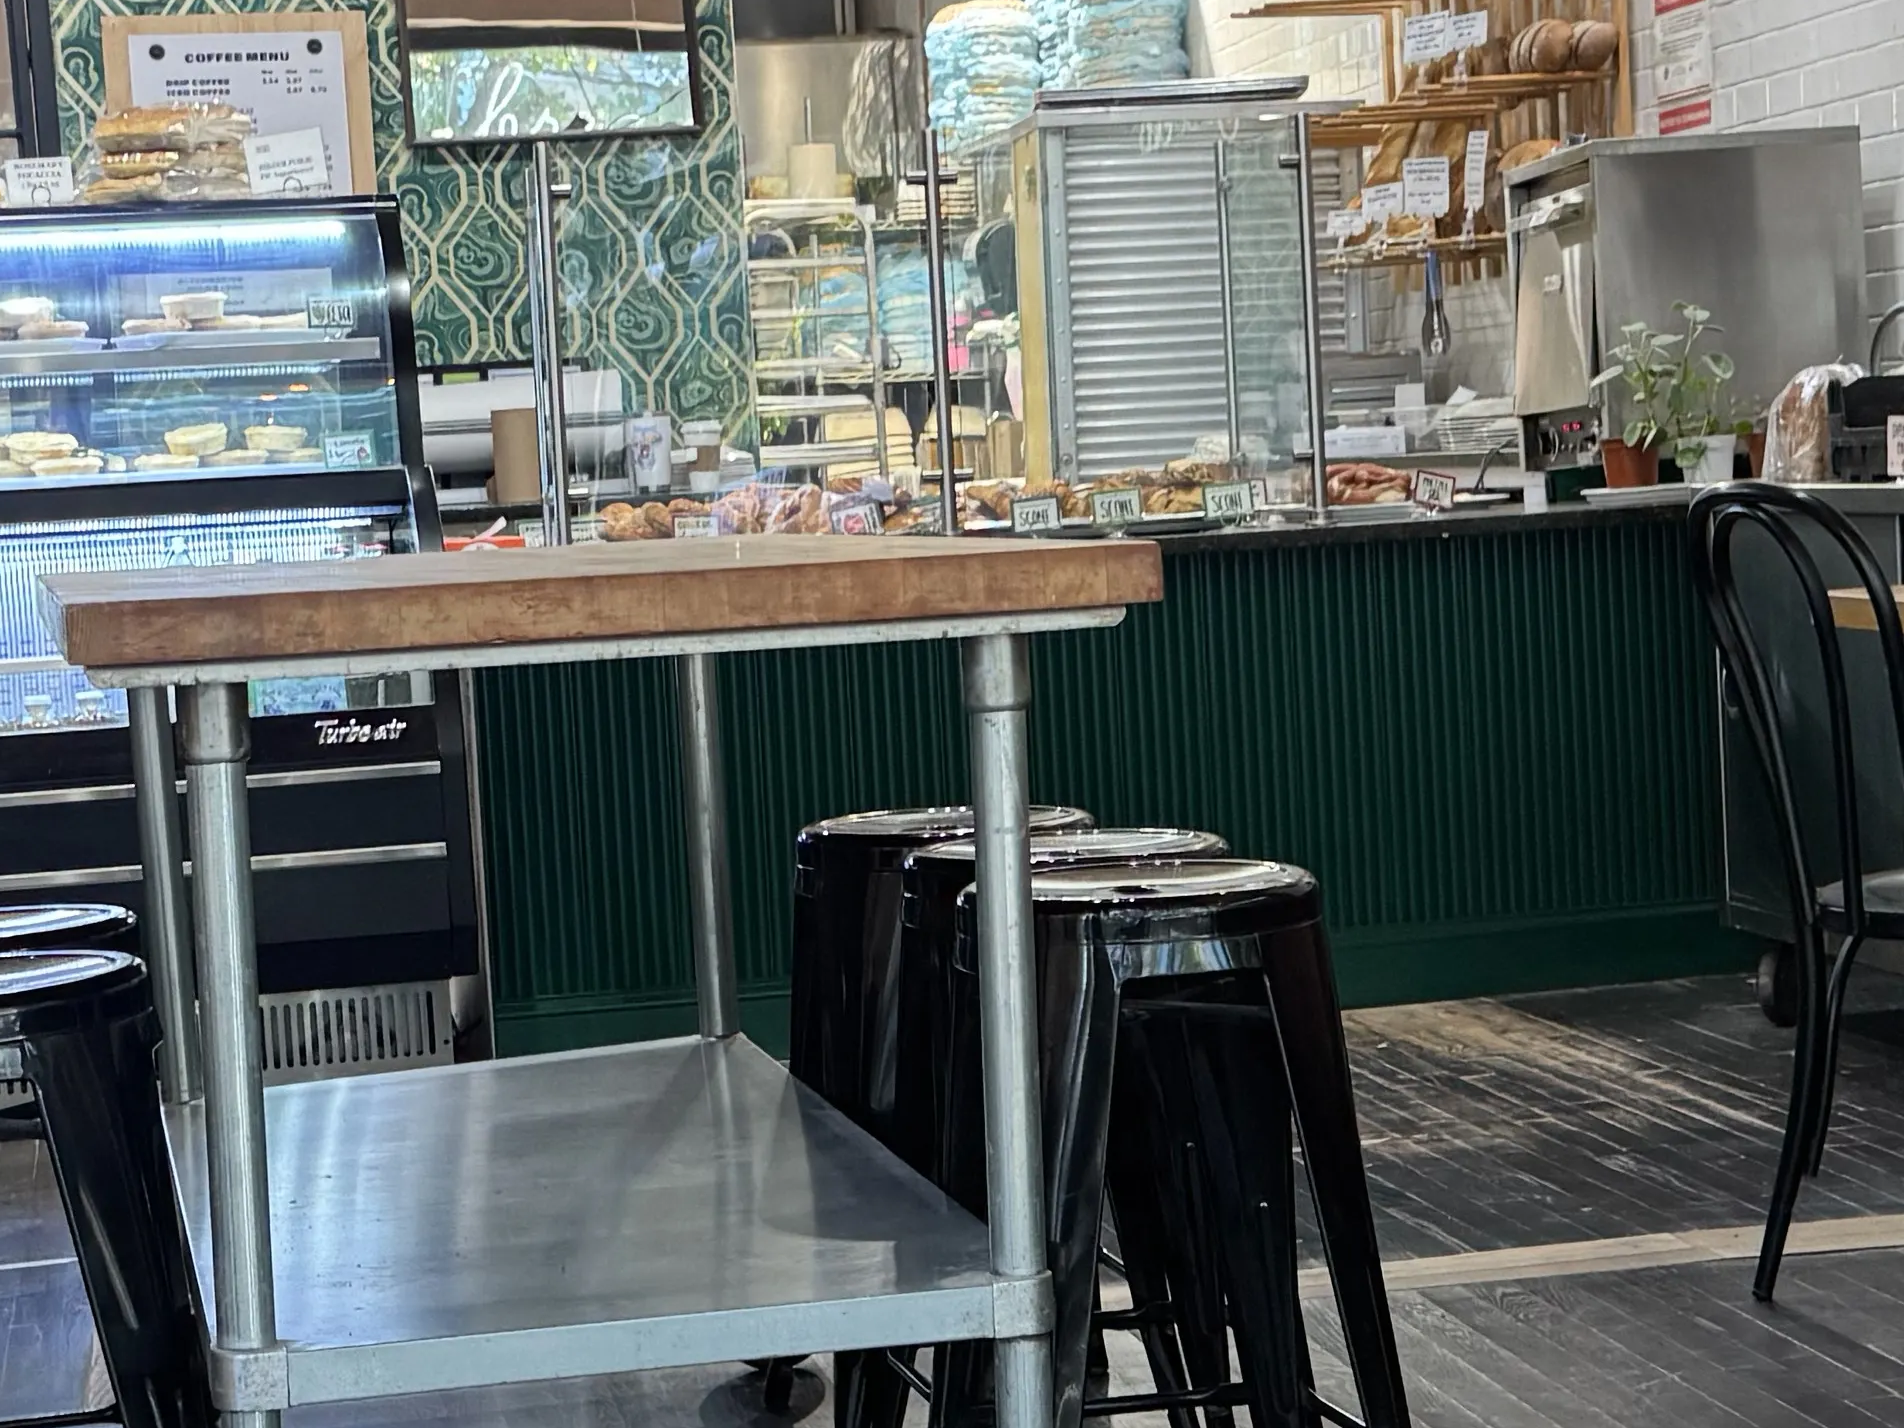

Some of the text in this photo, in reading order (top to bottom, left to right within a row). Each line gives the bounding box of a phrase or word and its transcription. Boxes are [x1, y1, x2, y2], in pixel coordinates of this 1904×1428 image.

[184, 50, 290, 64] COFFEE MENU
[314, 718, 372, 745] Turbo
